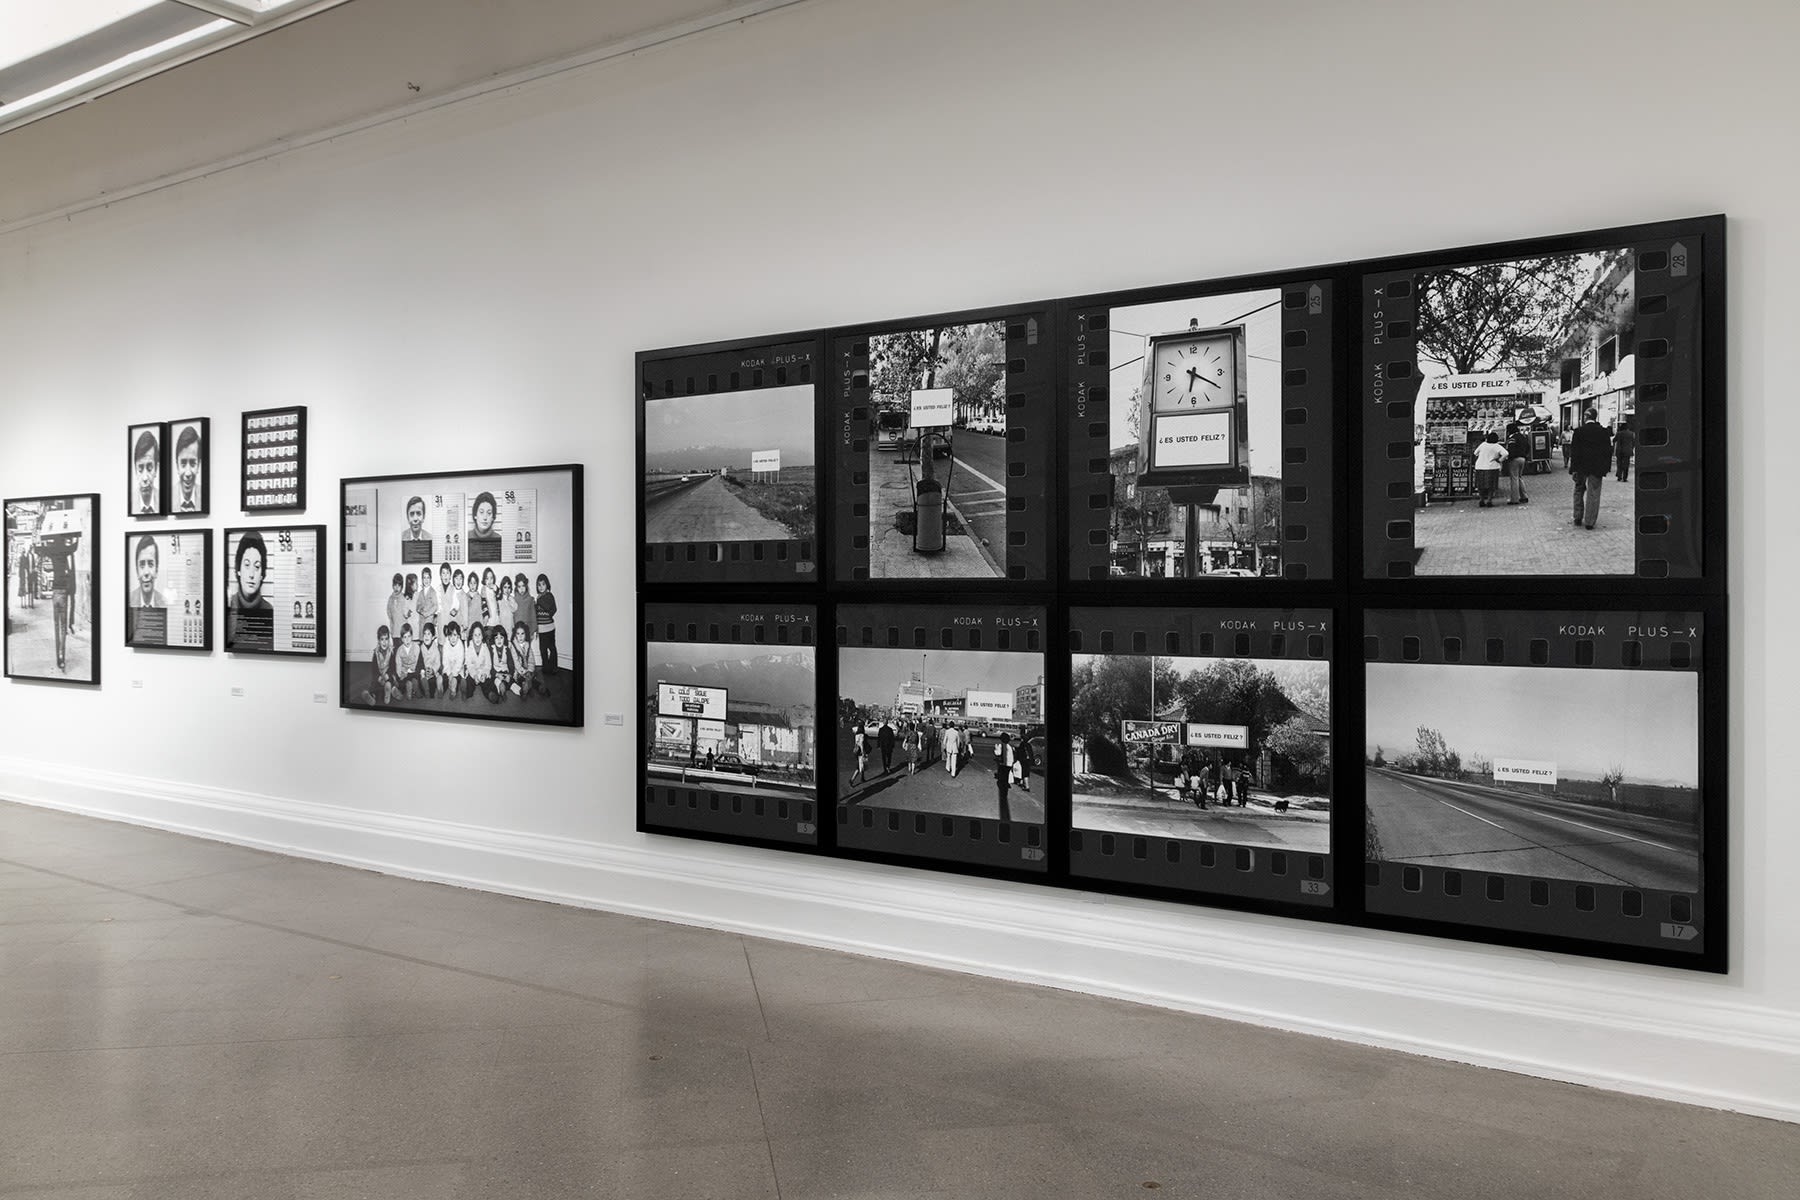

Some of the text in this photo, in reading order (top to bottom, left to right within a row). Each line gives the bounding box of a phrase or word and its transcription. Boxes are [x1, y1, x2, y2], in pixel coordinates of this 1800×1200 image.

[1672, 254, 1686, 268] 28
[1310, 295, 1321, 307] 25
[1189, 346, 1198, 354] 12
[741, 359, 766, 367] KODAK
[1217, 368, 1223, 376] 3
[1373, 363, 1384, 404] KODAK
[1451, 381, 1478, 389] USTED
[1077, 381, 1086, 418] KODAK
[1191, 396, 1197, 405] 6
[843, 411, 851, 445] KODAK
[1176, 435, 1199, 443] USTED
[279, 530, 291, 543] 58
[740, 614, 765, 622] KODAK
[953, 616, 983, 625] KODAK
[1220, 620, 1256, 630] KODAK
[1559, 625, 1606, 636] KODAK
[1125, 724, 1178, 742] CANADA DRY
[1308, 881, 1319, 893] 33
[1671, 925, 1684, 937] 17
